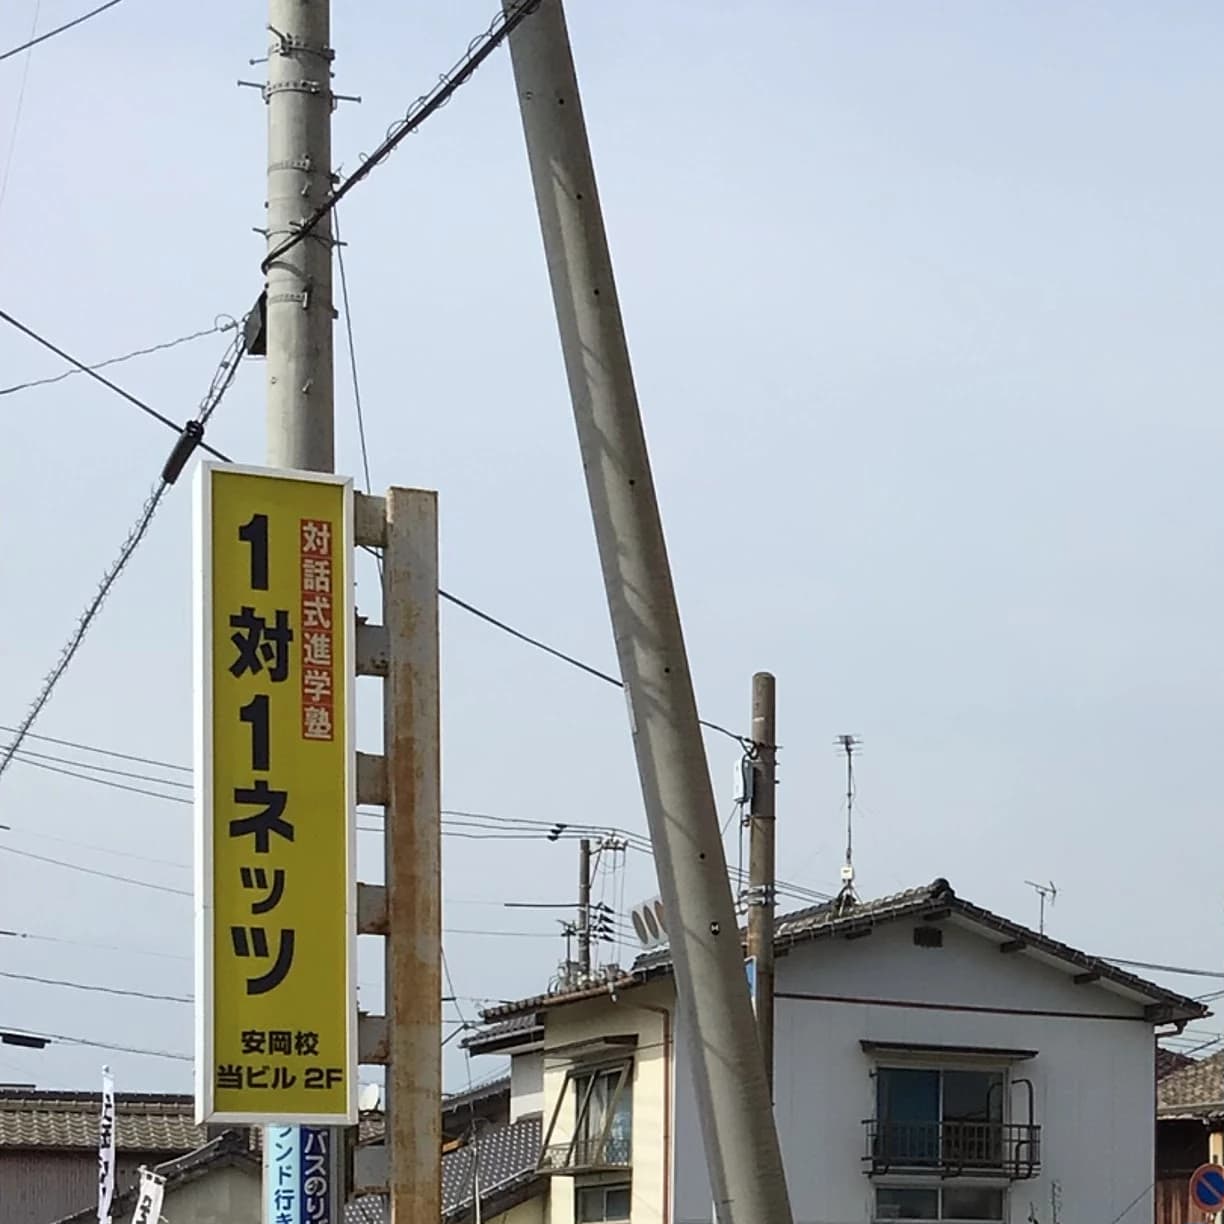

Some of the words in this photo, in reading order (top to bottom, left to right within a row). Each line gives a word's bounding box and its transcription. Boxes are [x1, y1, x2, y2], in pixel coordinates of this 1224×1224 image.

[303, 522, 331, 739] 対話式進学塾
[229, 514, 295, 995] 1対1ネッツ
[216, 1065, 296, 1091] 当ビル
[304, 1069, 343, 1090] 2F
[241, 1030, 319, 1057] 安岡校
